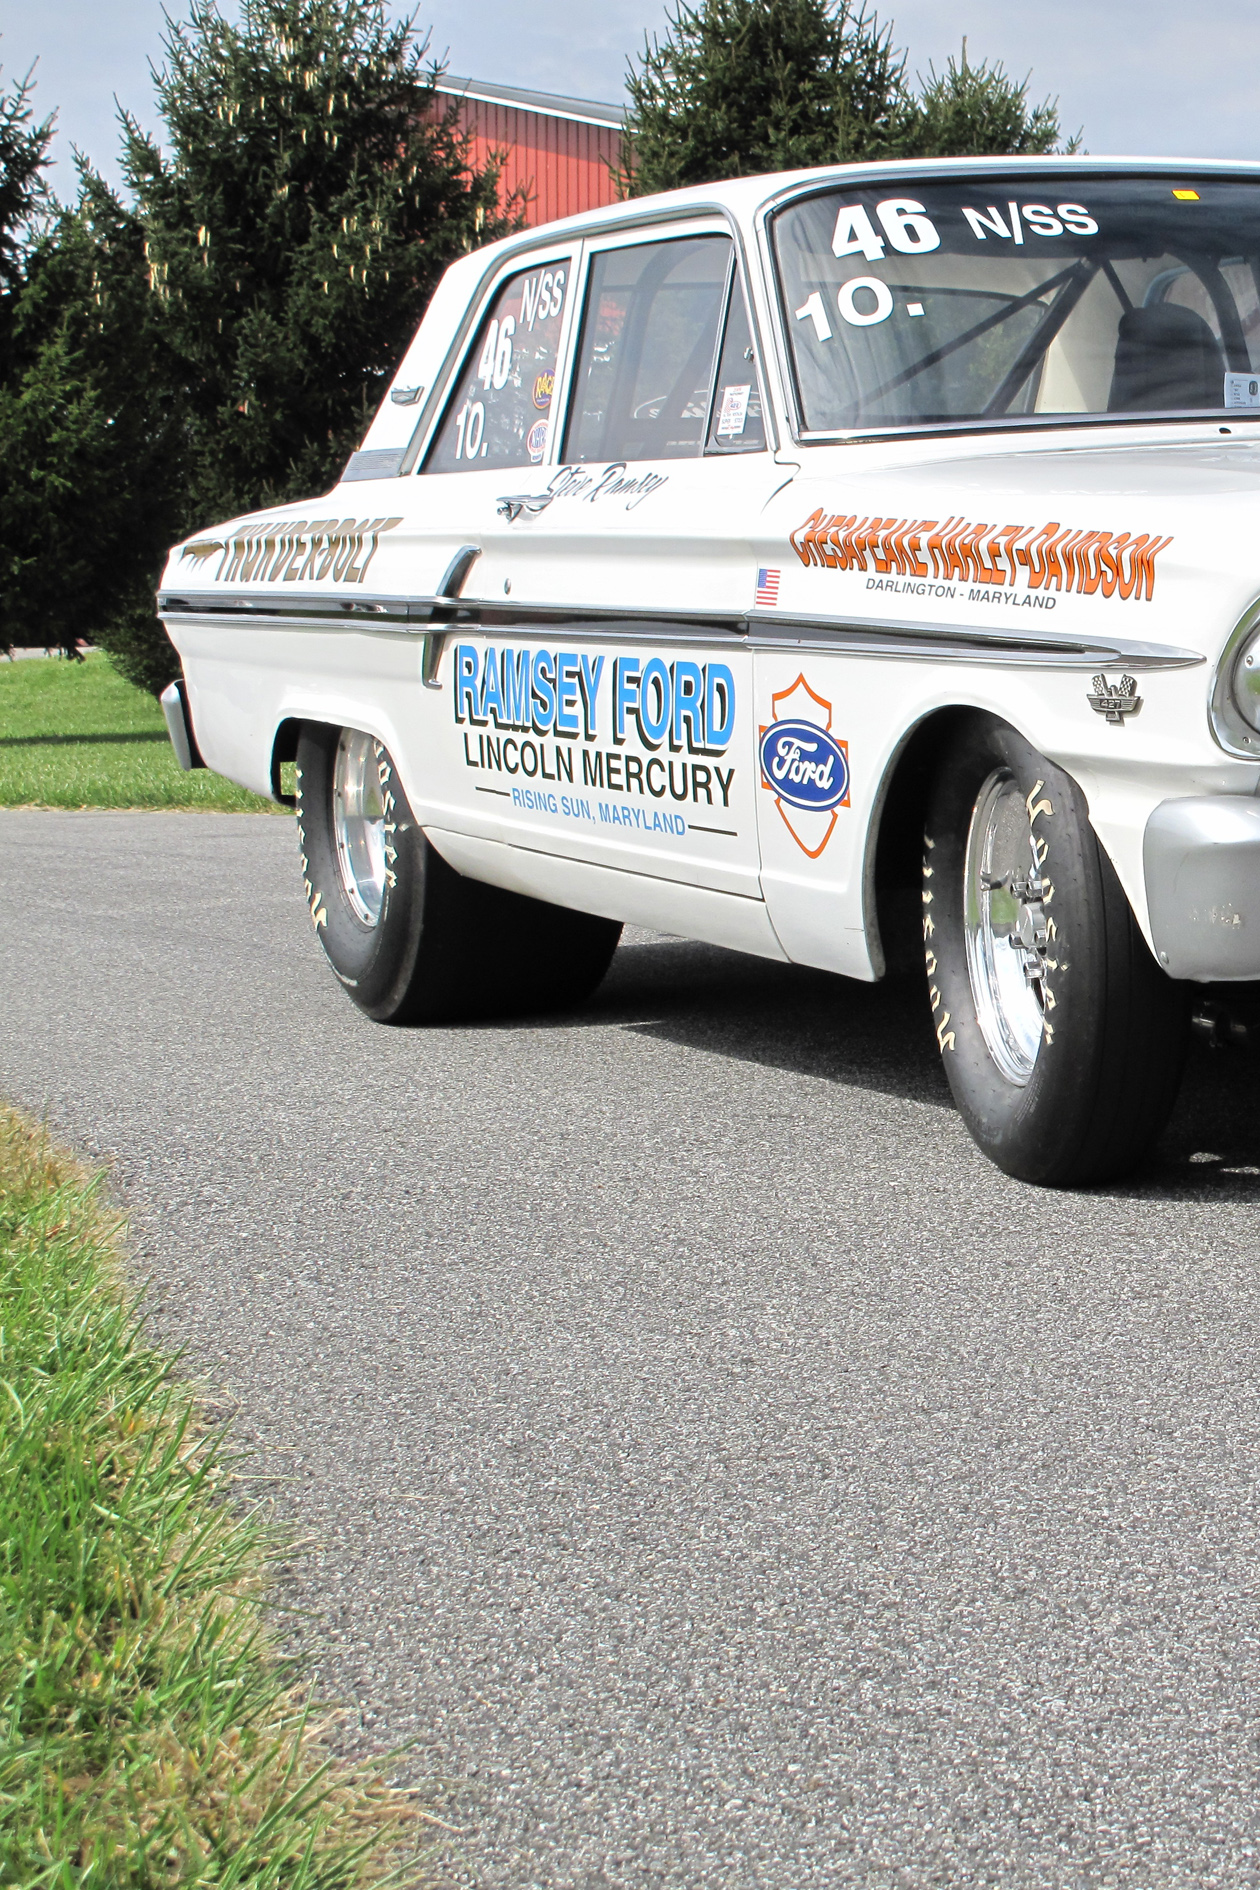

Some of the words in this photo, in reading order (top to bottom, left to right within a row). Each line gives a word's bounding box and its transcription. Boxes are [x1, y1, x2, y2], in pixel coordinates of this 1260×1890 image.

[831, 198, 941, 262] 46
[961, 201, 1099, 245] N/SS
[519, 269, 566, 332] N/SS
[794, 276, 925, 342] 10.
[478, 315, 516, 390] 46
[456, 401, 488, 460] 10.
[547, 466, 592, 498] Steve
[583, 463, 669, 511] Ramsey
[215, 517, 403, 583] THUNDERBOLT
[789, 507, 939, 578] CHESAPEAKE
[927, 516, 1173, 602] HARLEY-DAVIDSON
[866, 578, 956, 599] DARLINGTON
[968, 588, 1057, 610] MARYLAND
[454, 644, 605, 742] RAMSEY
[613, 656, 736, 758] FORD
[1101, 699, 1121, 709] 427
[464, 732, 574, 784] LINCOLN
[582, 748, 736, 808] MERCURY
[772, 736, 836, 790] Ford
[512, 787, 558, 814] RISING
[560, 795, 596, 825] SUN,
[598, 802, 686, 836] MARYLAND
